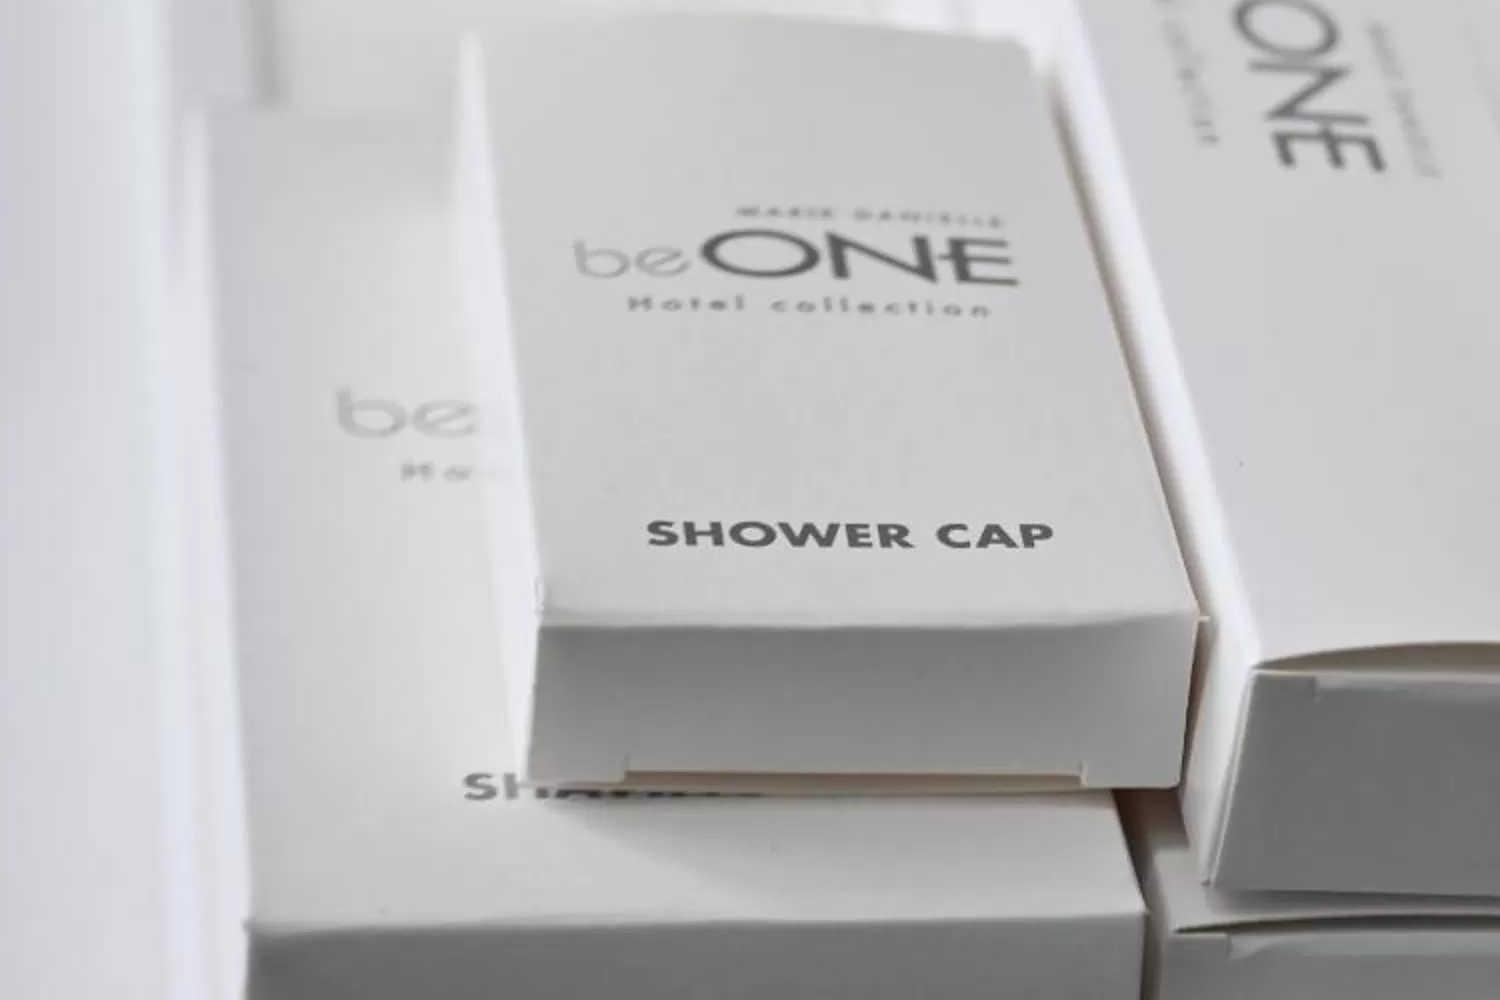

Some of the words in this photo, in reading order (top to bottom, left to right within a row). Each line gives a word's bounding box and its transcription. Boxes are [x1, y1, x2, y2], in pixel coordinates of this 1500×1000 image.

[627, 296, 746, 314] Hotel
[770, 299, 992, 318] collection
[646, 520, 914, 549] SHOWER
[936, 523, 1054, 549] CAP
